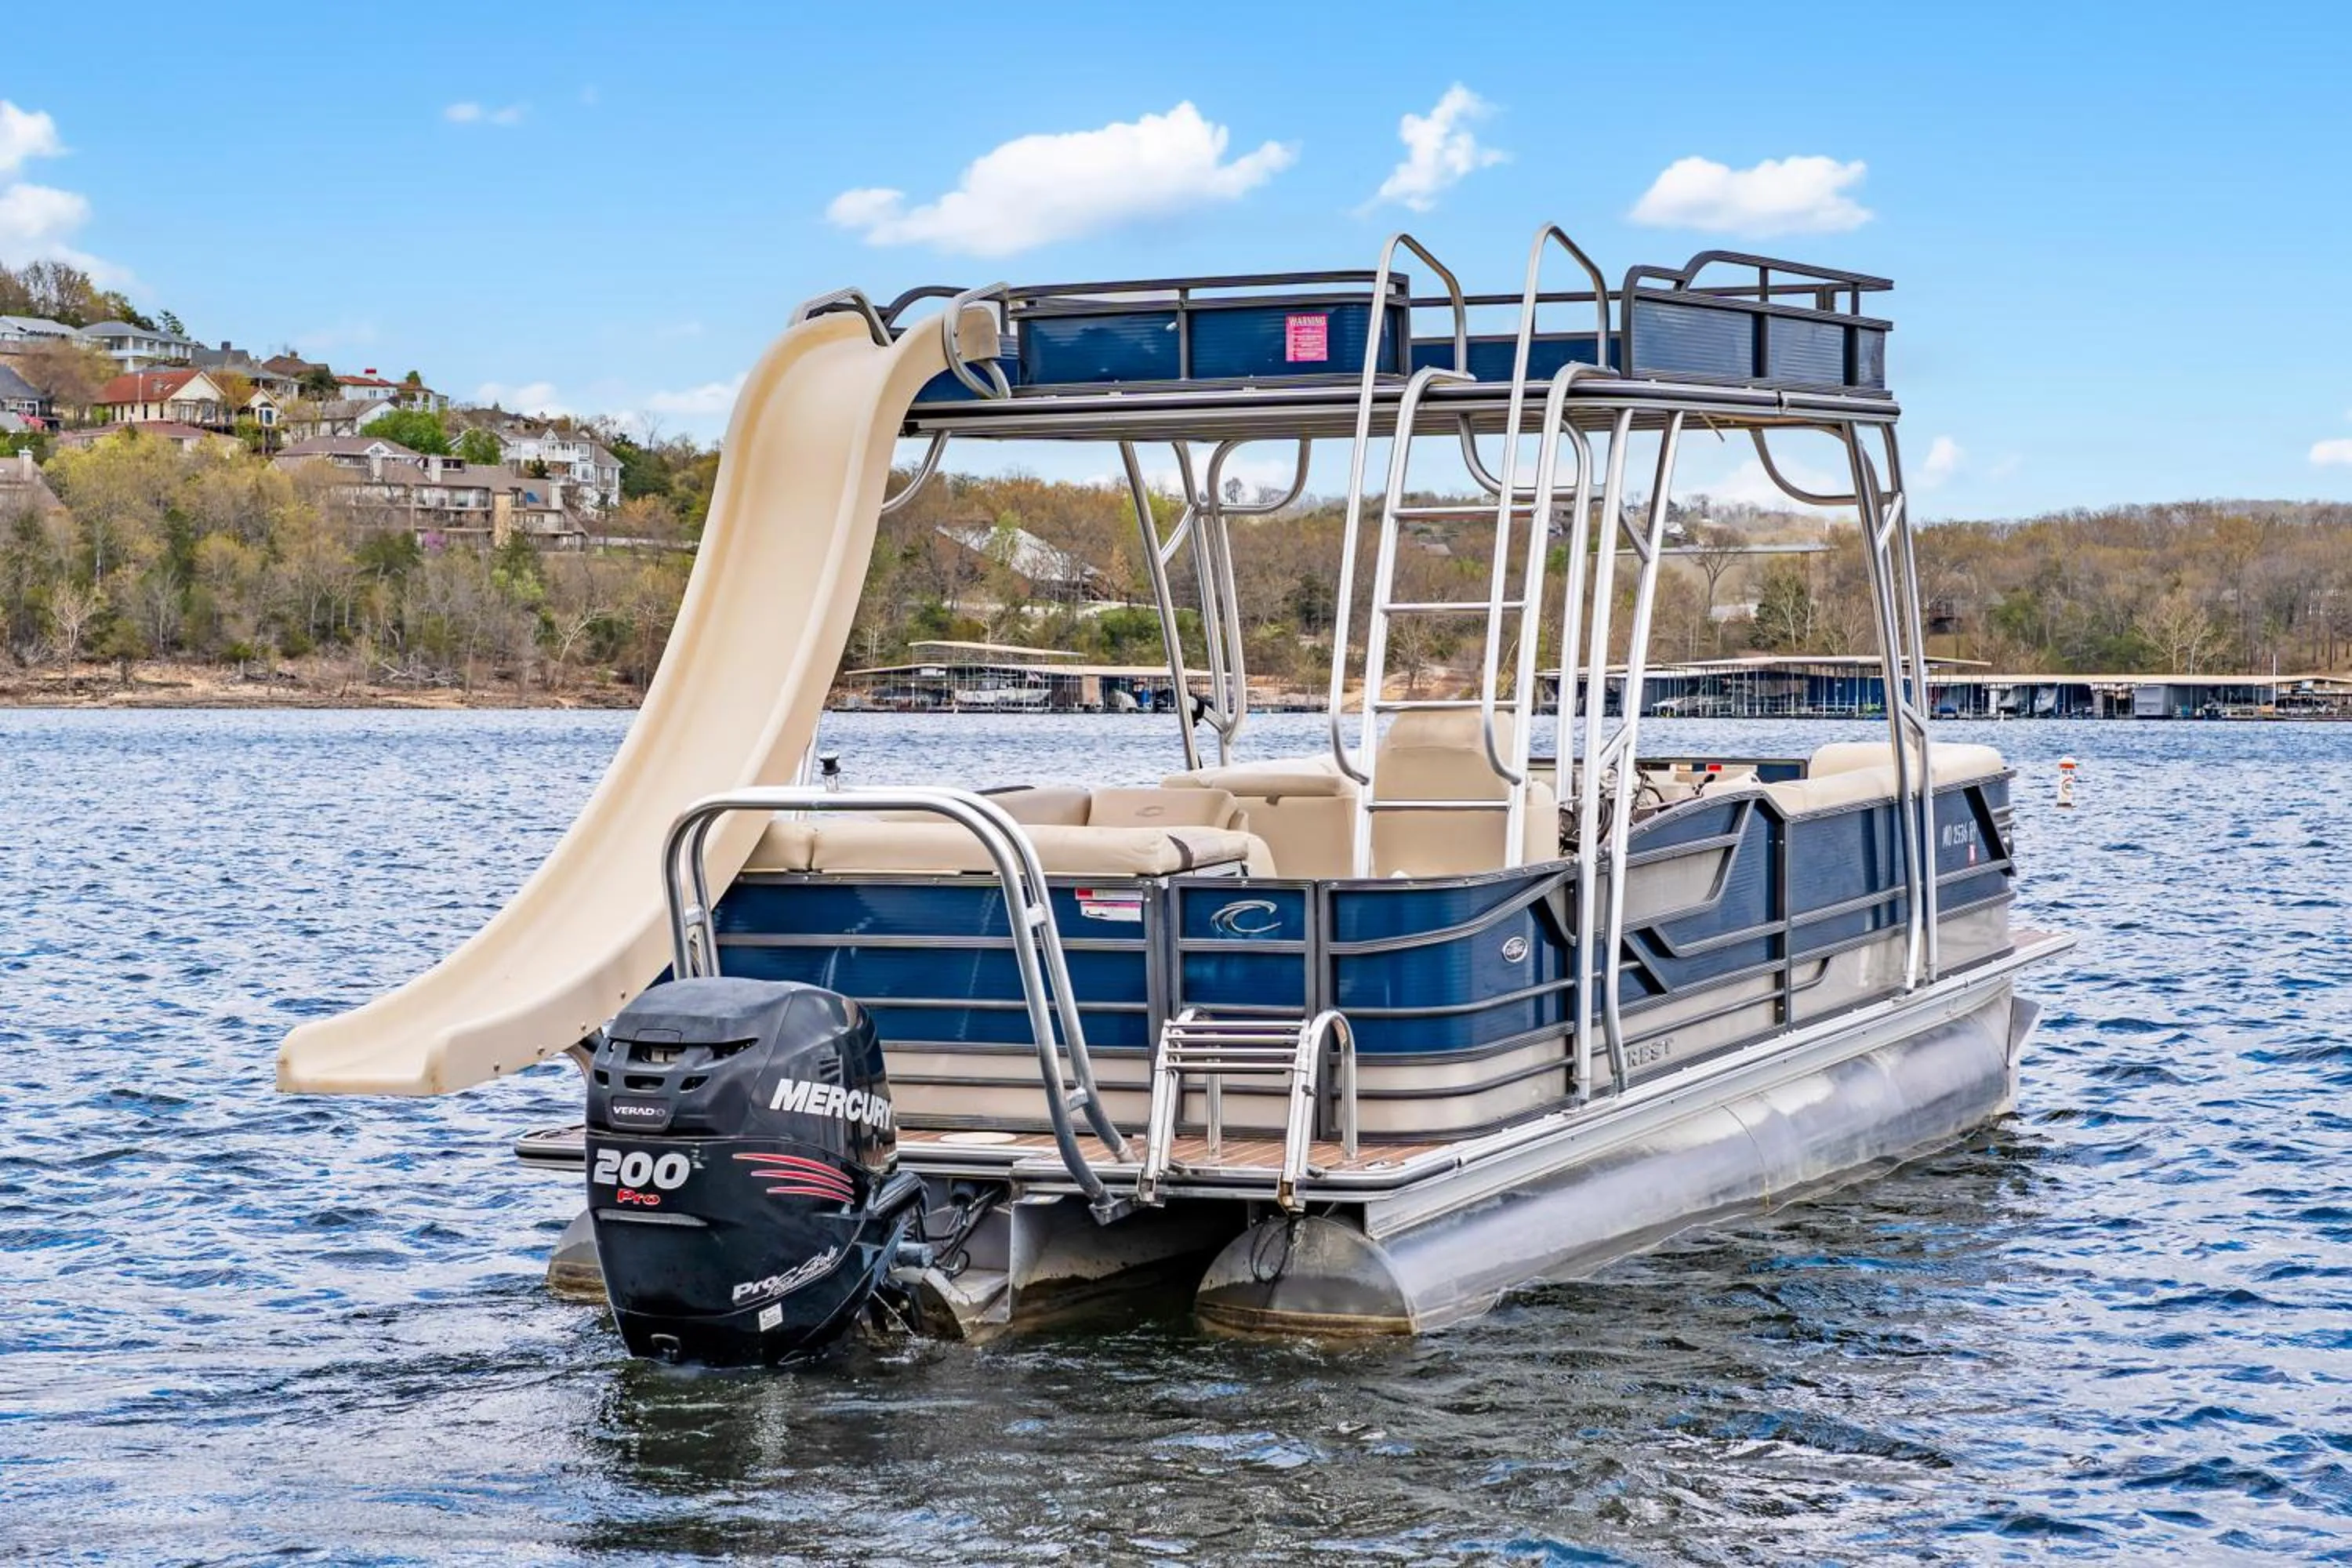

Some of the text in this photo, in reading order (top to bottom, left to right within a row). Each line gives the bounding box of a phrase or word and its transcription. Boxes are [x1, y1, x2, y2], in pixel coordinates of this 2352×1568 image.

[1288, 316, 1325, 326] WARNING
[1624, 1037, 1675, 1067] REST
[613, 1105, 666, 1117] VERADO
[769, 1078, 892, 1131] MERCURY
[593, 1148, 691, 1189] 200
[616, 1188, 661, 1205] Pro
